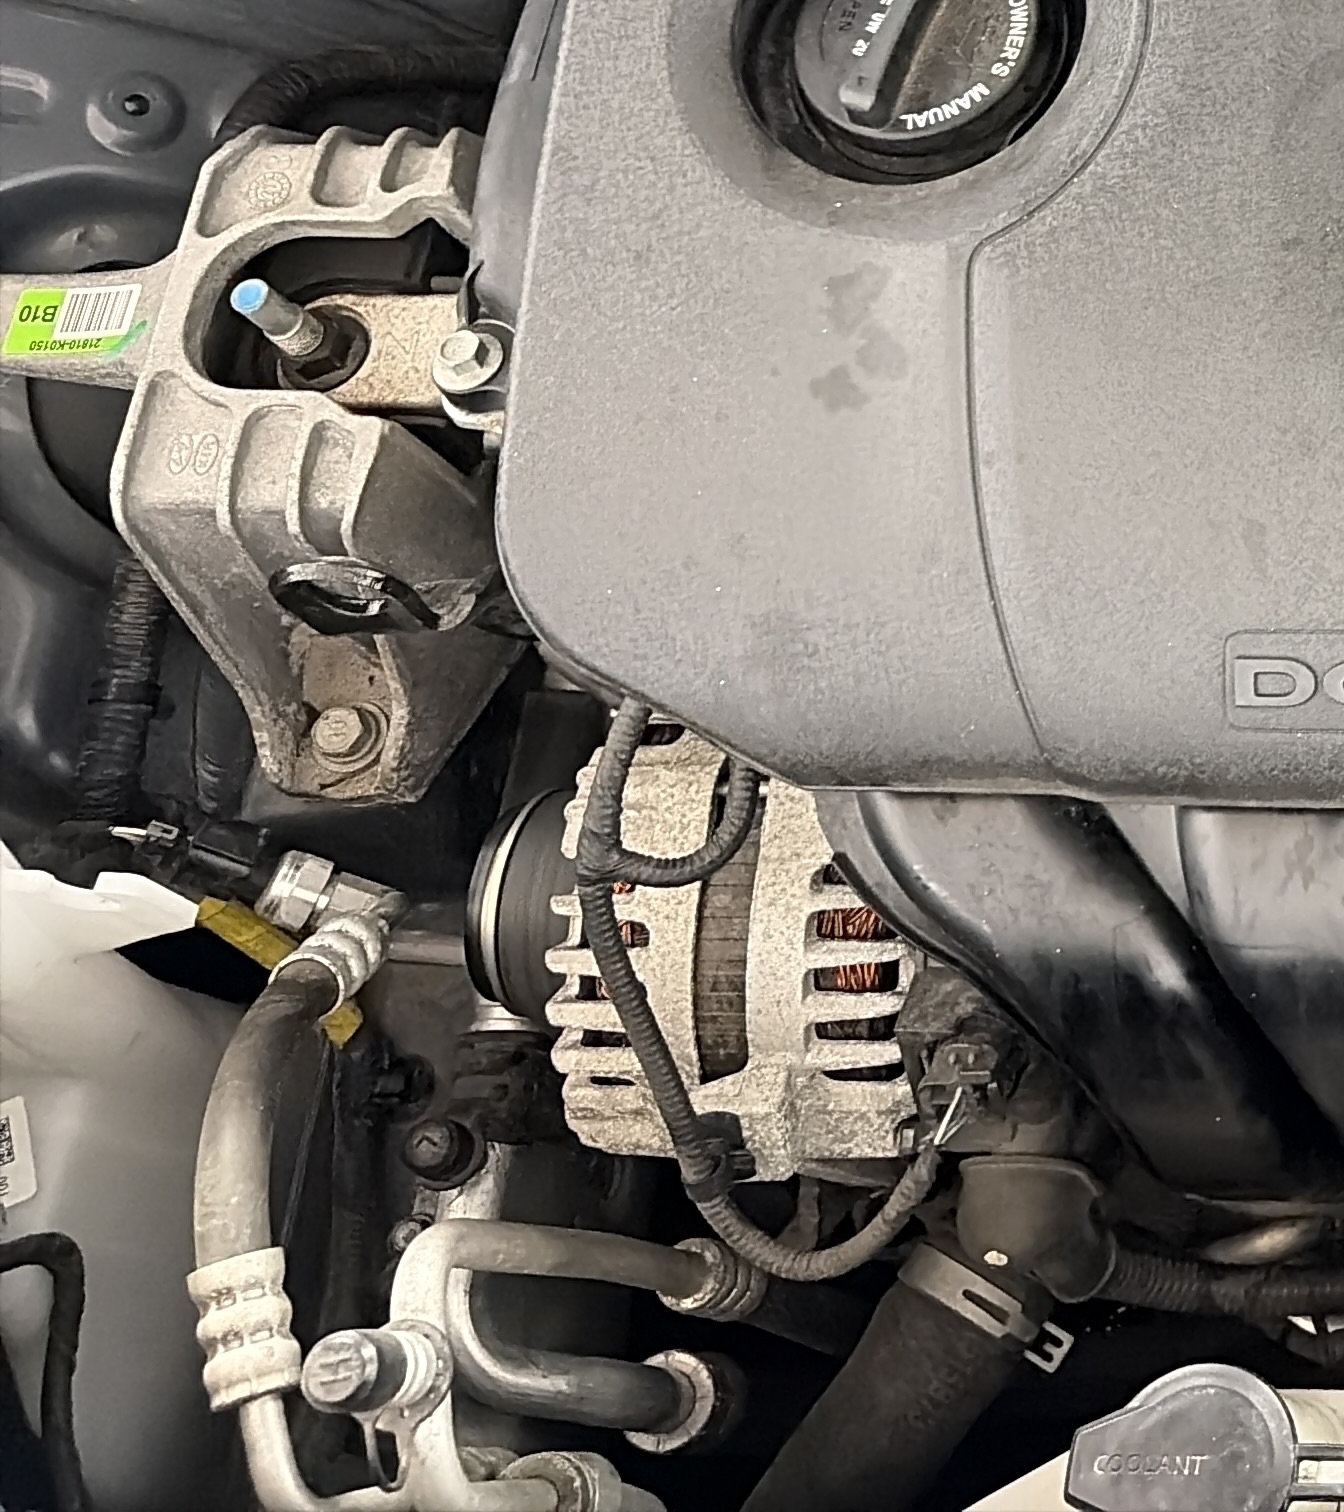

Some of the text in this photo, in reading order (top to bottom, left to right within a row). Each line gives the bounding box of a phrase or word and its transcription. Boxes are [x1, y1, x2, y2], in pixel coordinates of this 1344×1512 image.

[898, 81, 991, 130] MANUAL
[19, 305, 59, 323] B10
[29, 338, 102, 351] 21810-K0150
[1092, 1453, 1208, 1477] COOLANT
